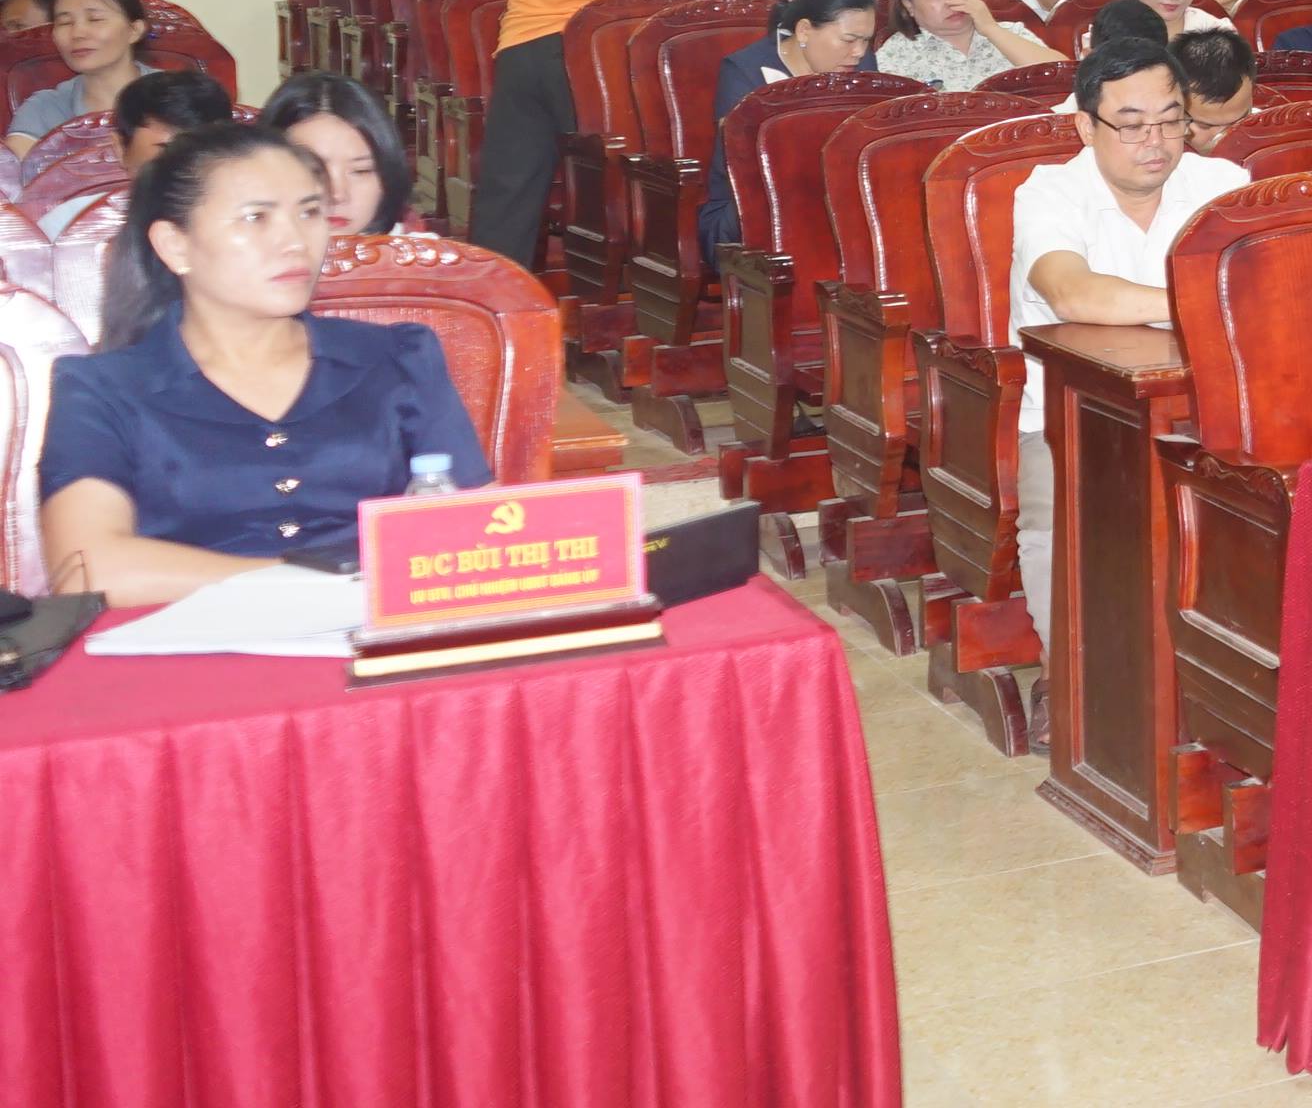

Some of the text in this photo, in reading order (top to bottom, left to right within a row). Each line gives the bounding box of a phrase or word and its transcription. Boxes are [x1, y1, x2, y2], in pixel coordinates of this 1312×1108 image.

[409, 535, 599, 581] Đ/C BÙI THỊ THI
